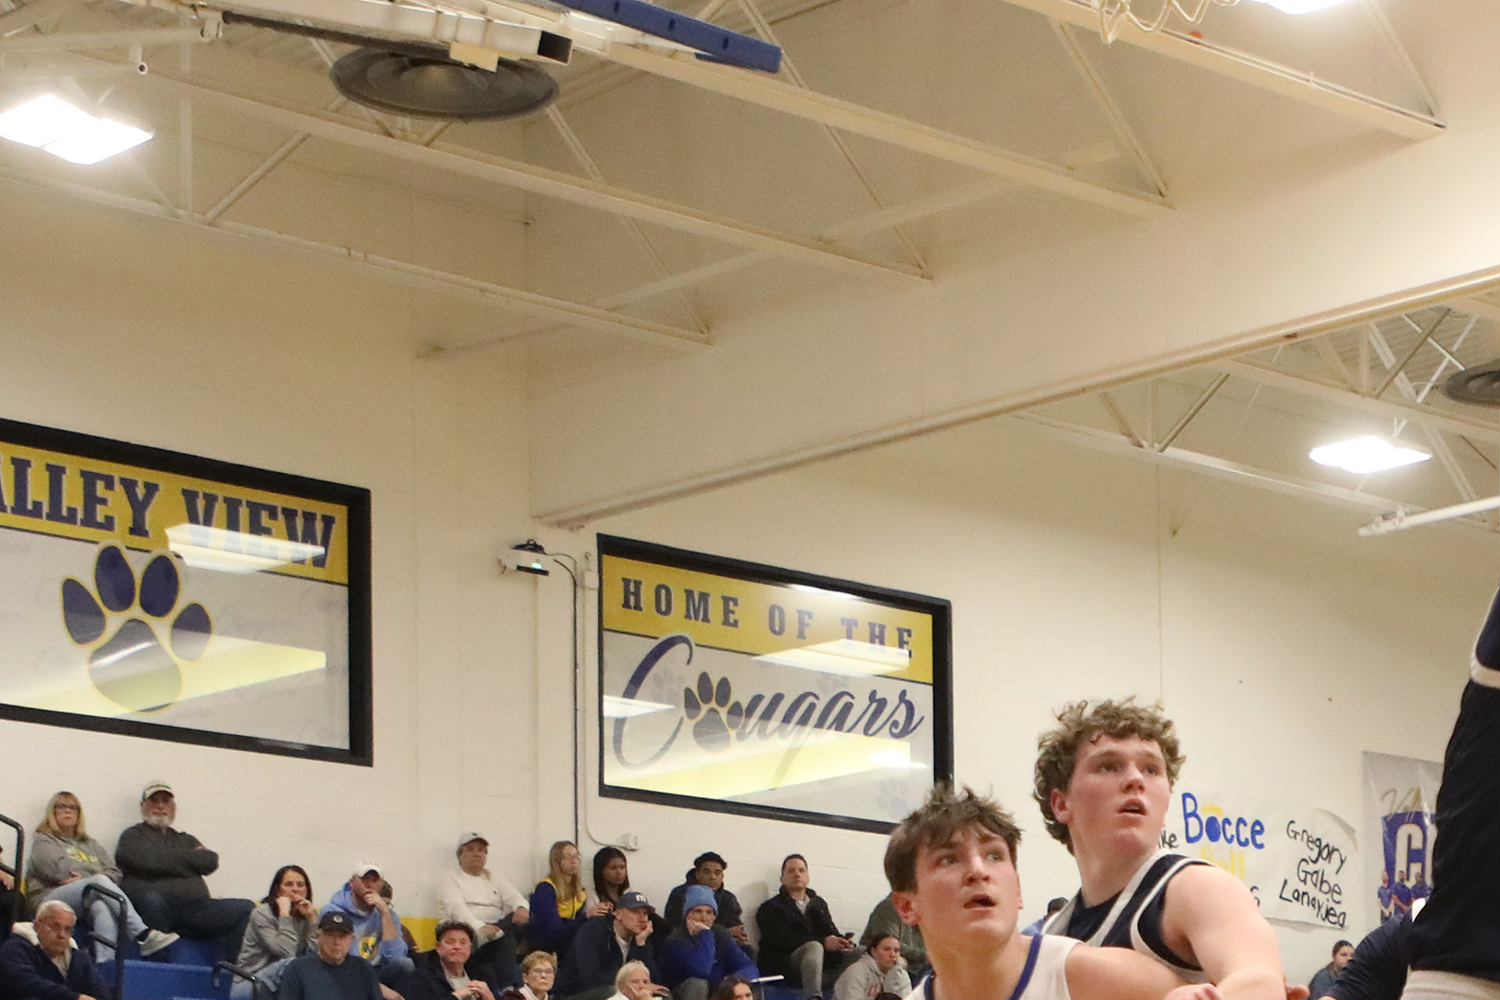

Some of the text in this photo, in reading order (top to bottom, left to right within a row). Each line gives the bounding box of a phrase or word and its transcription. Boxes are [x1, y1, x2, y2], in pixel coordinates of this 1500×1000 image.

[182, 487, 337, 569] VIEW
[621, 577, 913, 659] HOME OF THE
[1182, 792, 1265, 849] Bocce
[1297, 858, 1342, 904] Gabe
